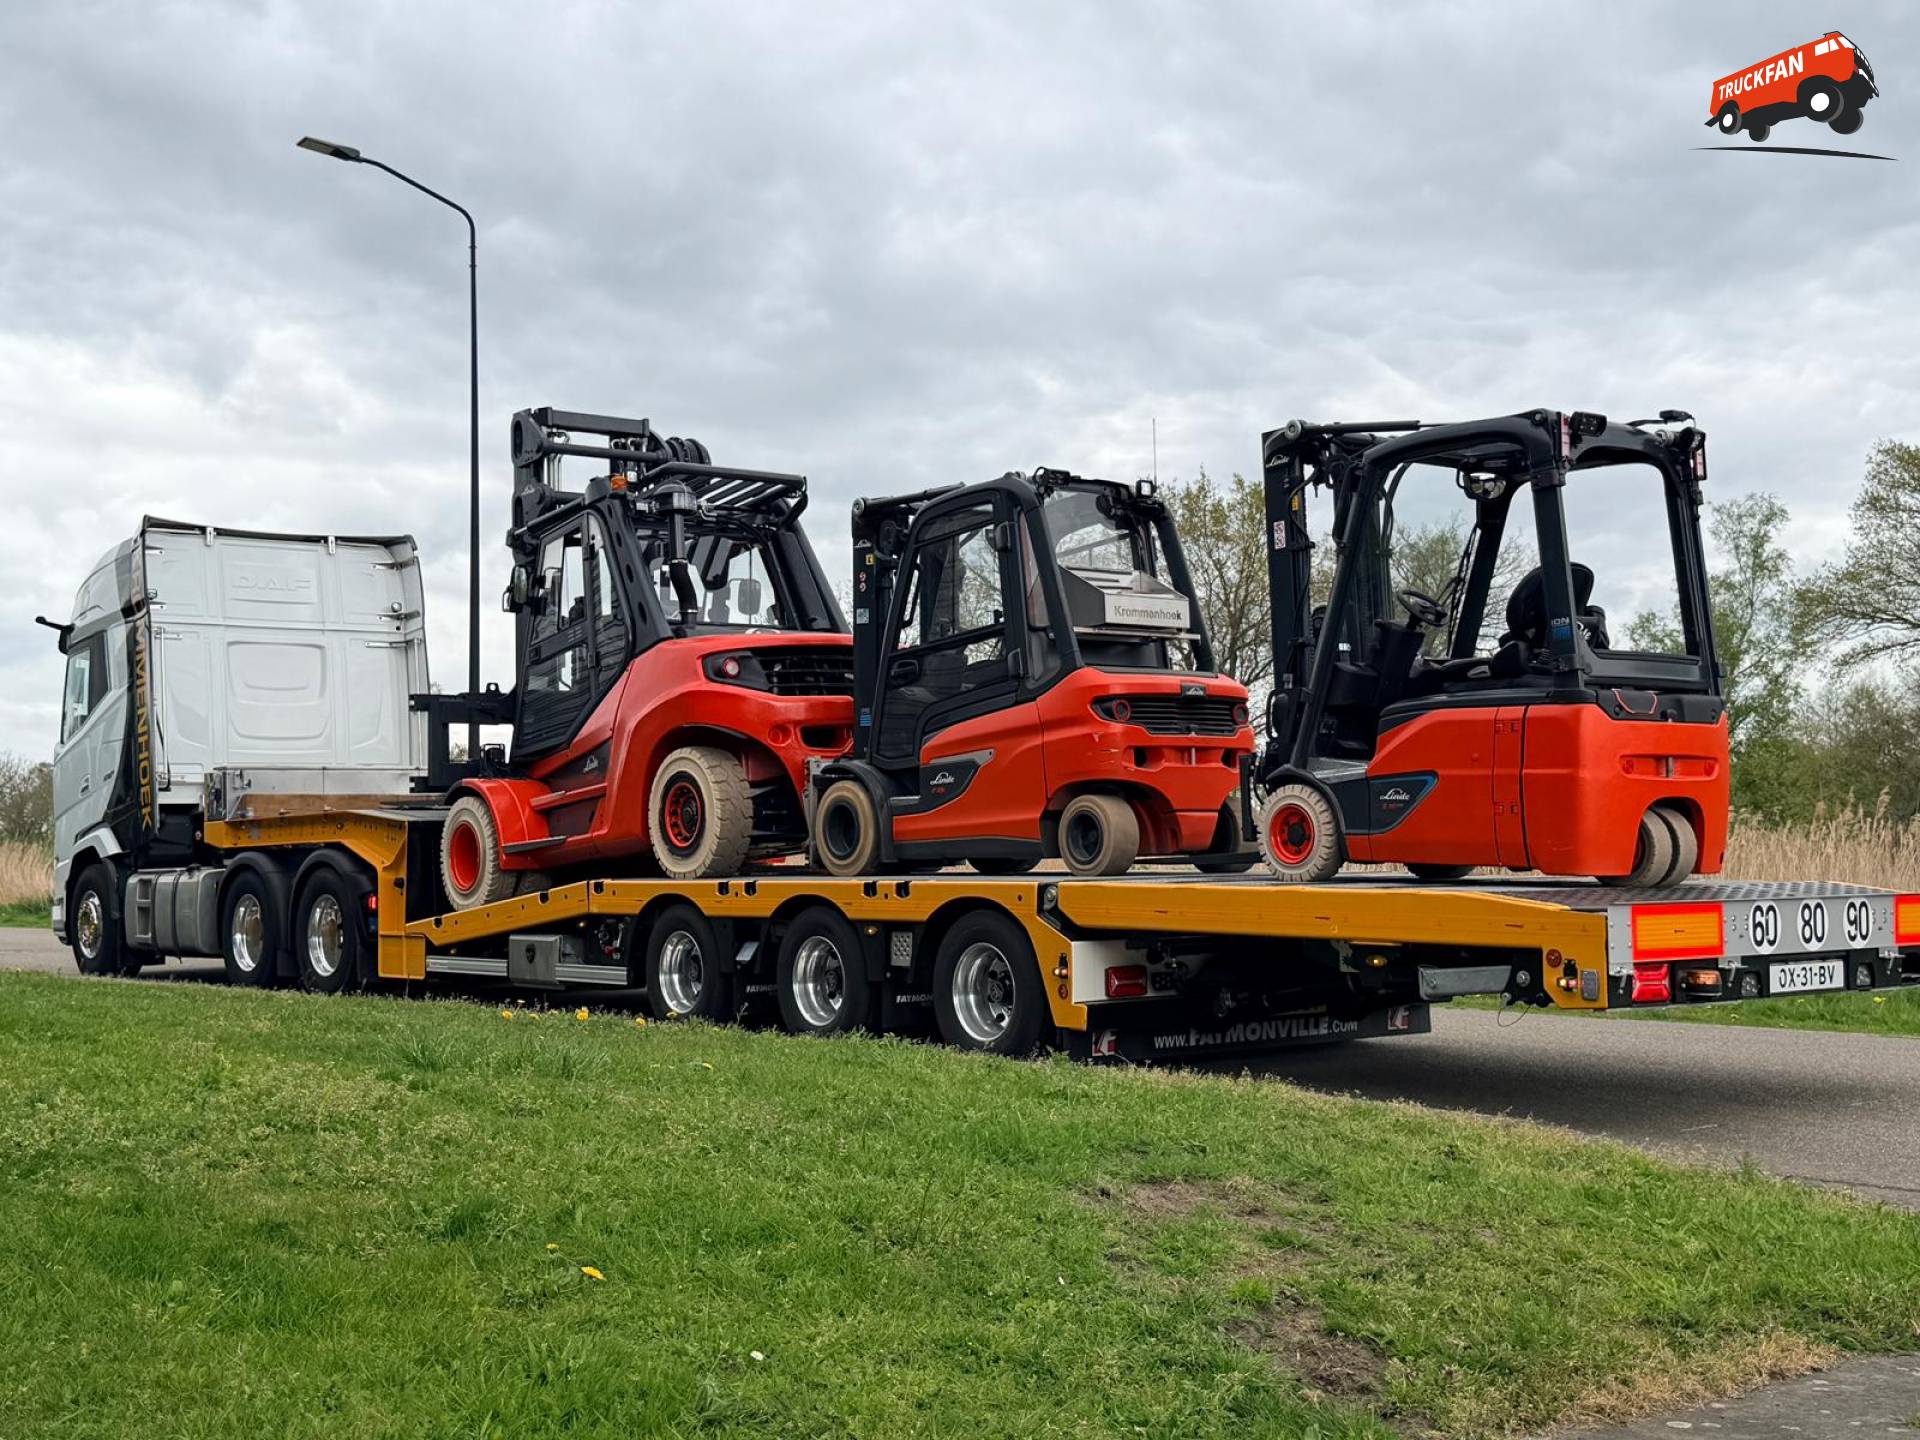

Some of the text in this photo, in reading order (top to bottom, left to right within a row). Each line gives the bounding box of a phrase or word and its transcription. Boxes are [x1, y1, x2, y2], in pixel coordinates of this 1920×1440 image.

[1752, 900, 1870, 948] 60 80 90
[1778, 964, 1836, 989] OX-31-BV
